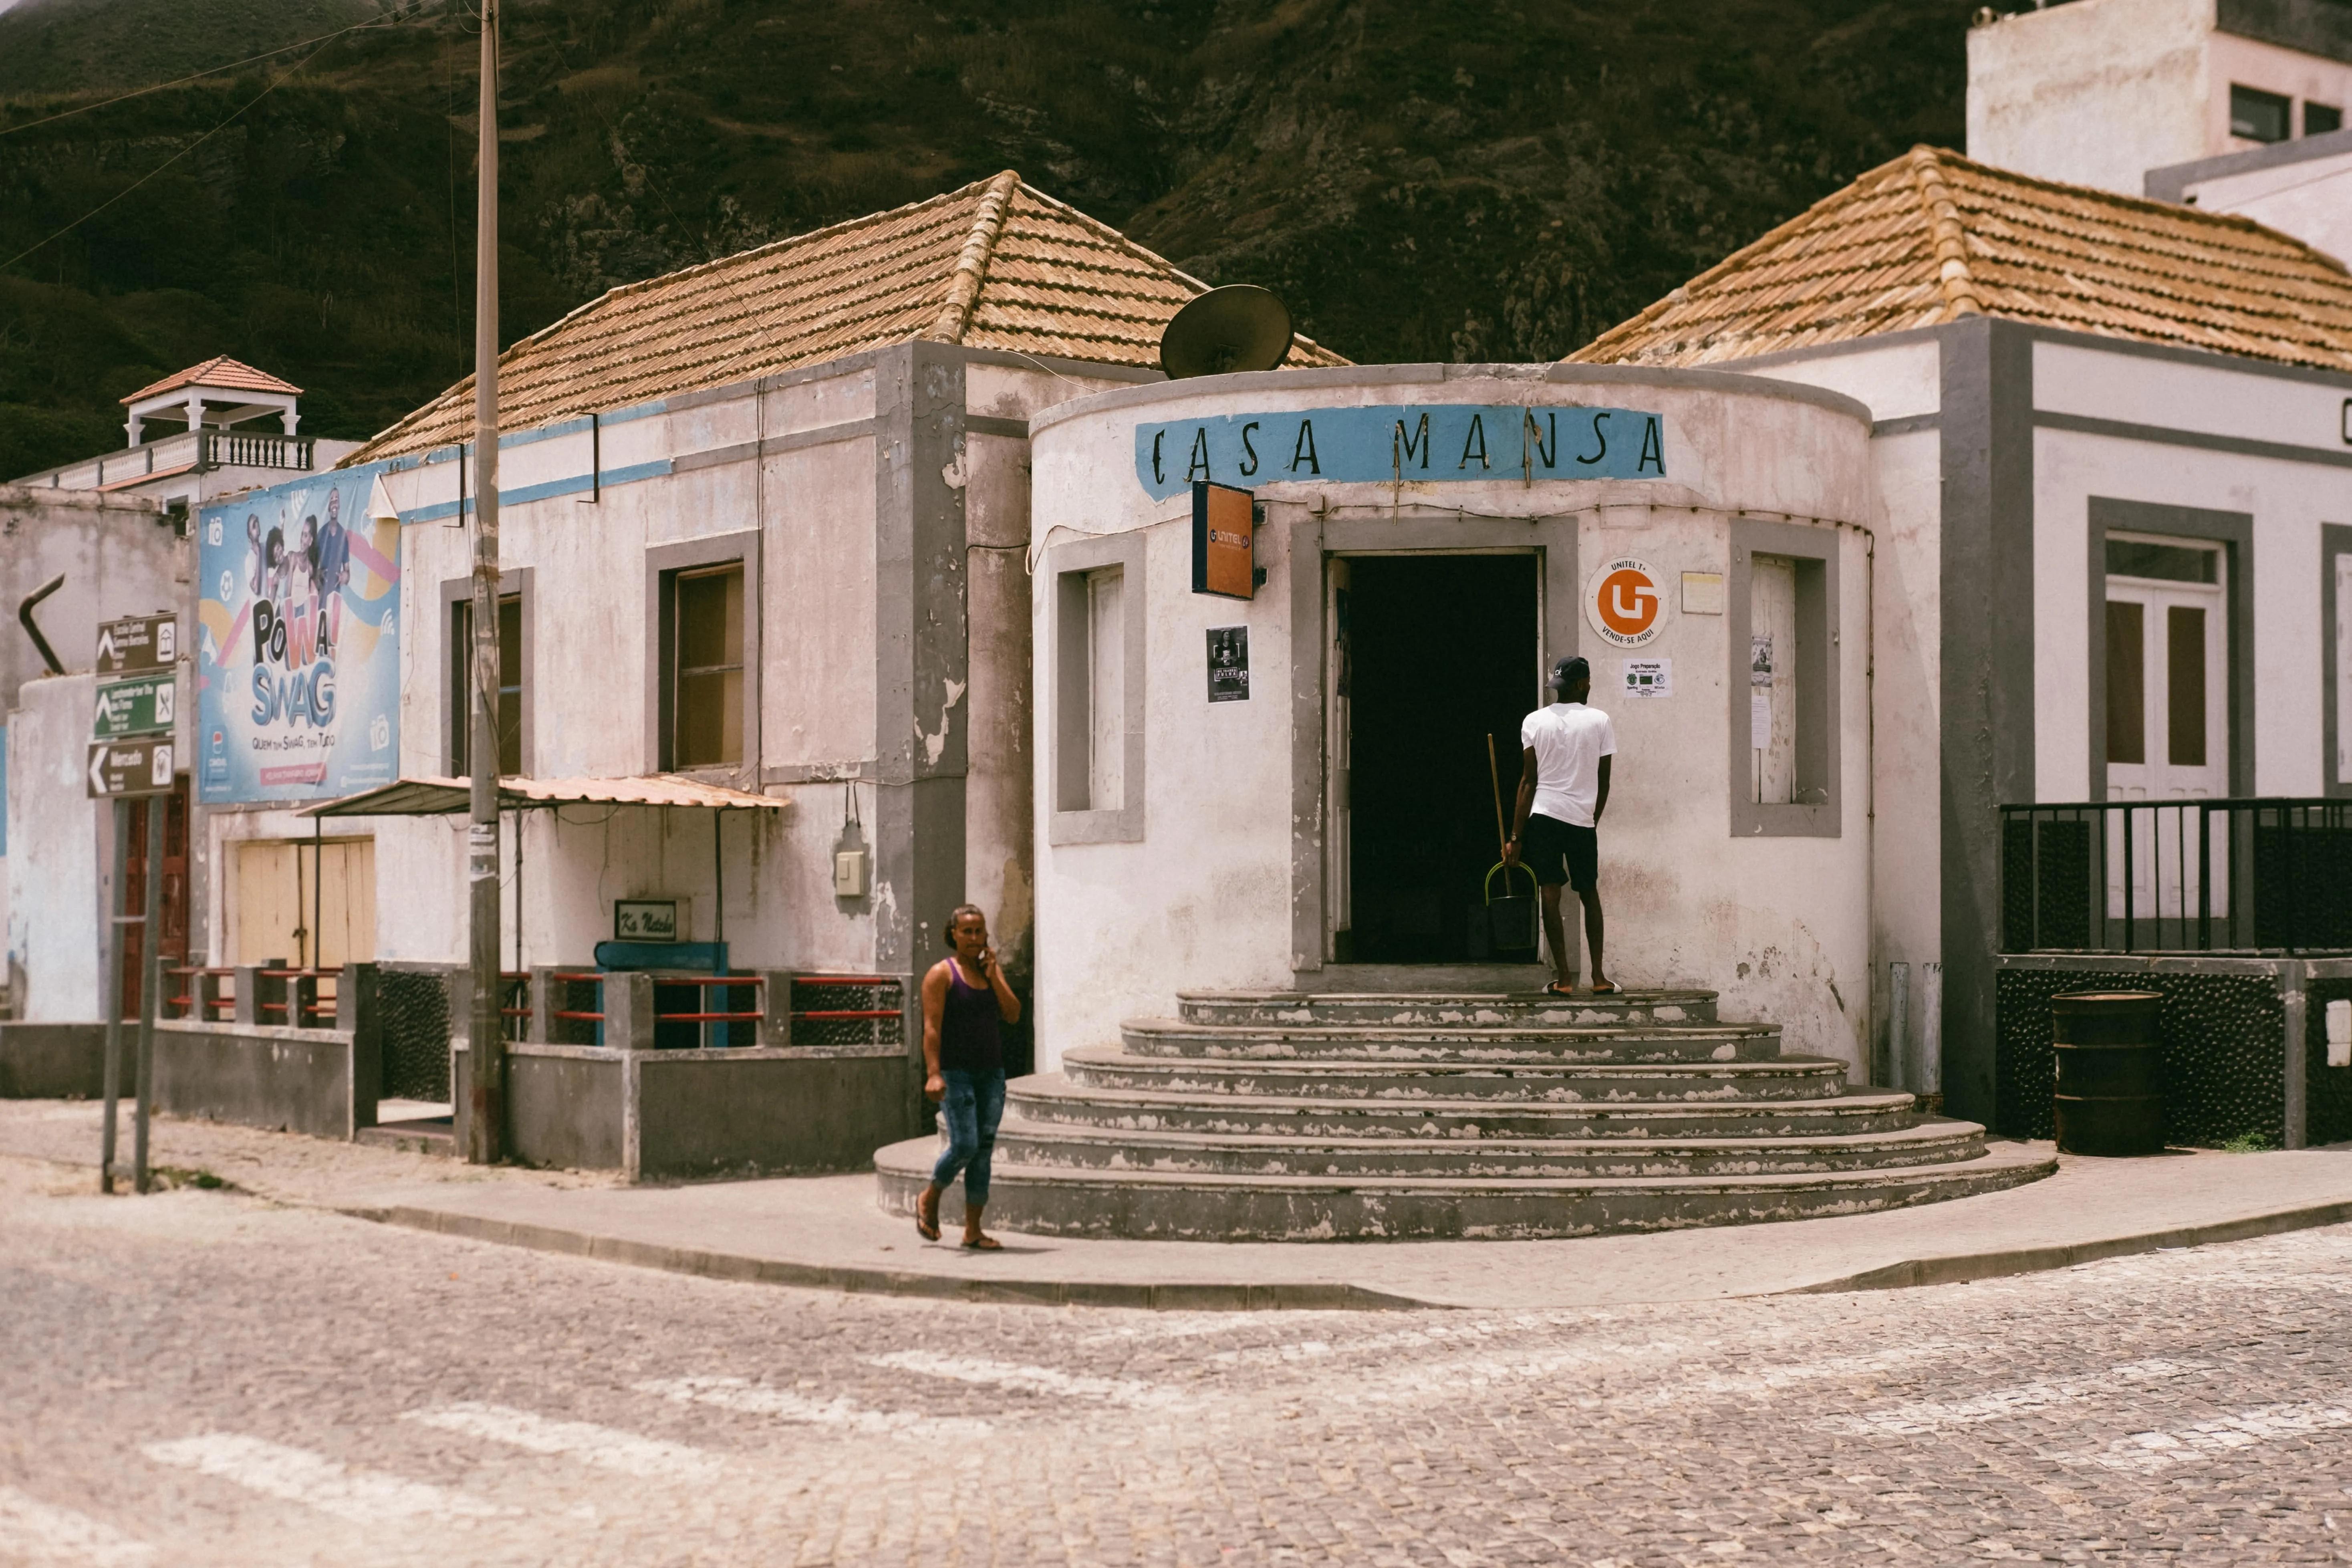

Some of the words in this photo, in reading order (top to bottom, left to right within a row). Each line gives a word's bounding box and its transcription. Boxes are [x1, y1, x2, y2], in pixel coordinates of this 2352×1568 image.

[1152, 419, 1321, 484] CASA
[1393, 412, 1664, 474] MANSA
[1218, 531, 1241, 544] UNITEL
[1611, 561, 1636, 570] UNITEL
[1602, 626, 1635, 643] VENDE-SE
[1638, 629, 1654, 643] AQUI
[252, 660, 335, 729] SWAG
[253, 737, 272, 751] QUEM
